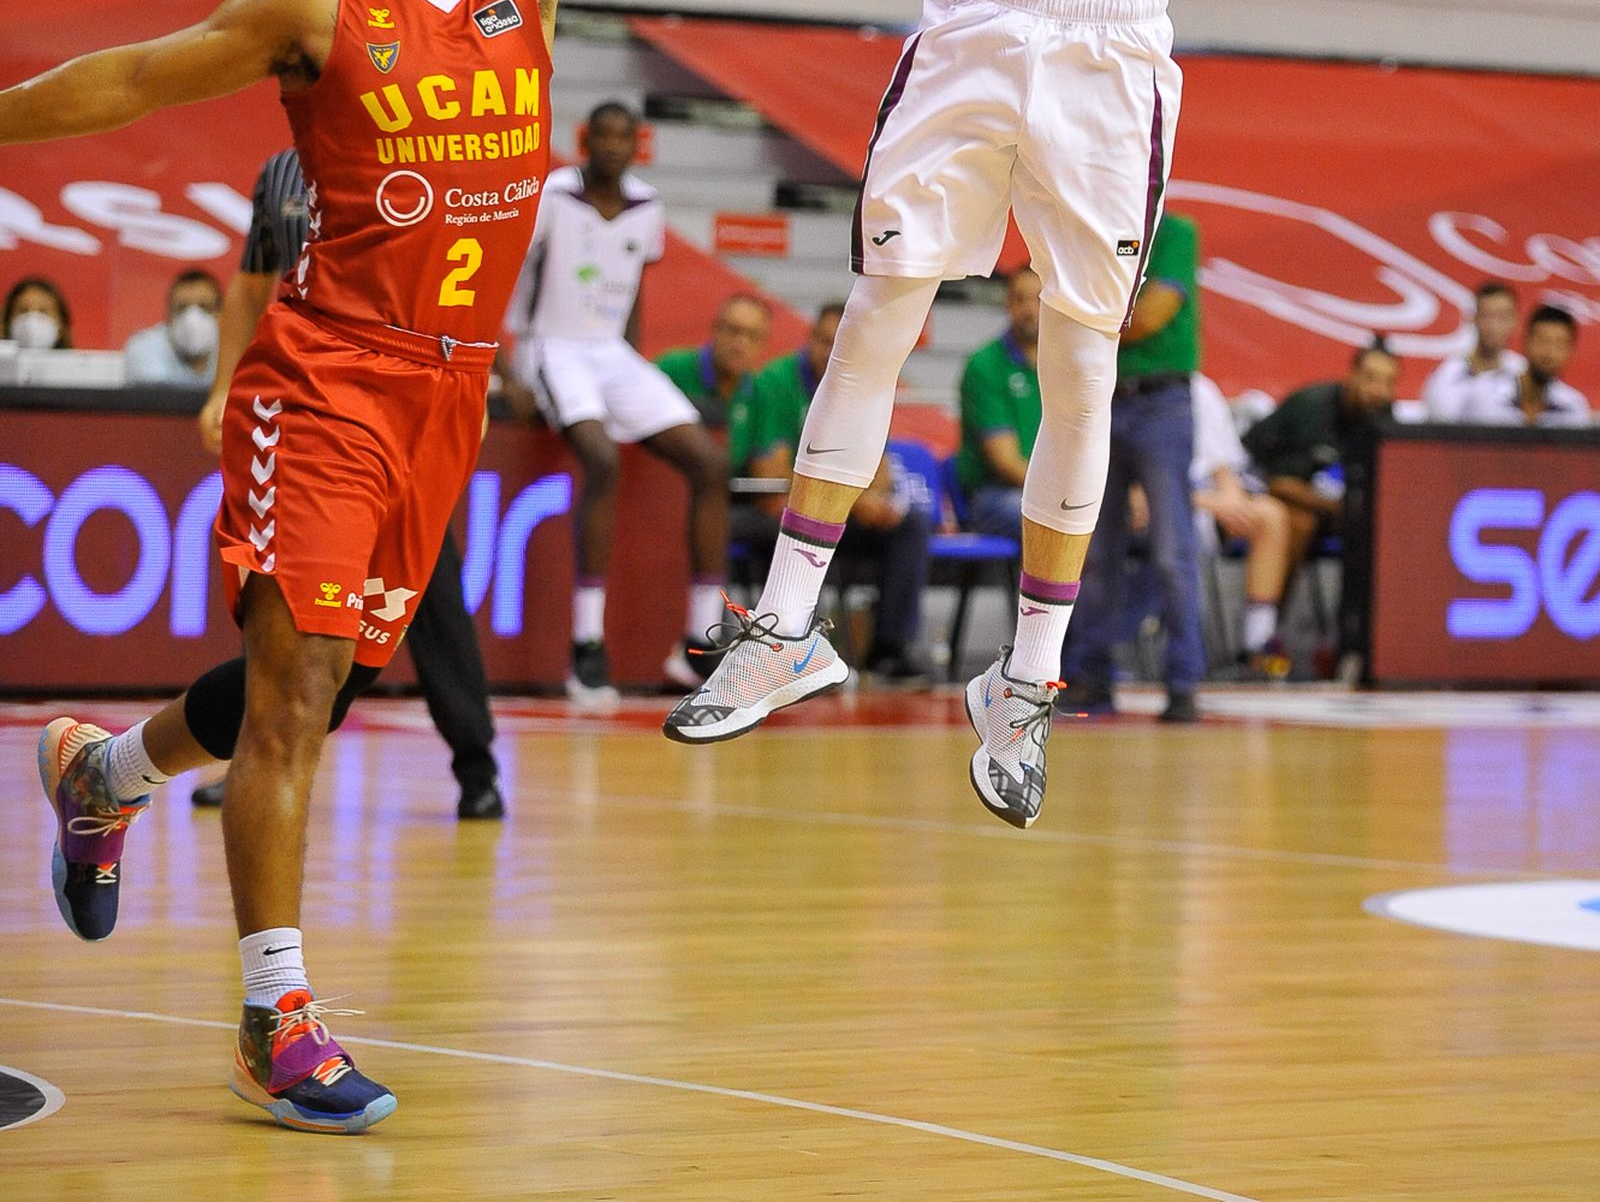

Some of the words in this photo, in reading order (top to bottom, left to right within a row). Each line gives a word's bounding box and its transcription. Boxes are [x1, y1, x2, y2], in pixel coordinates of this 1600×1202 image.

[360, 68, 540, 133] UCAM
[376, 121, 541, 164] UNIVERSIDAD
[445, 188, 499, 207] Costa
[445, 213, 478, 227] Región
[479, 212, 492, 223] de
[438, 238, 483, 306] 2
